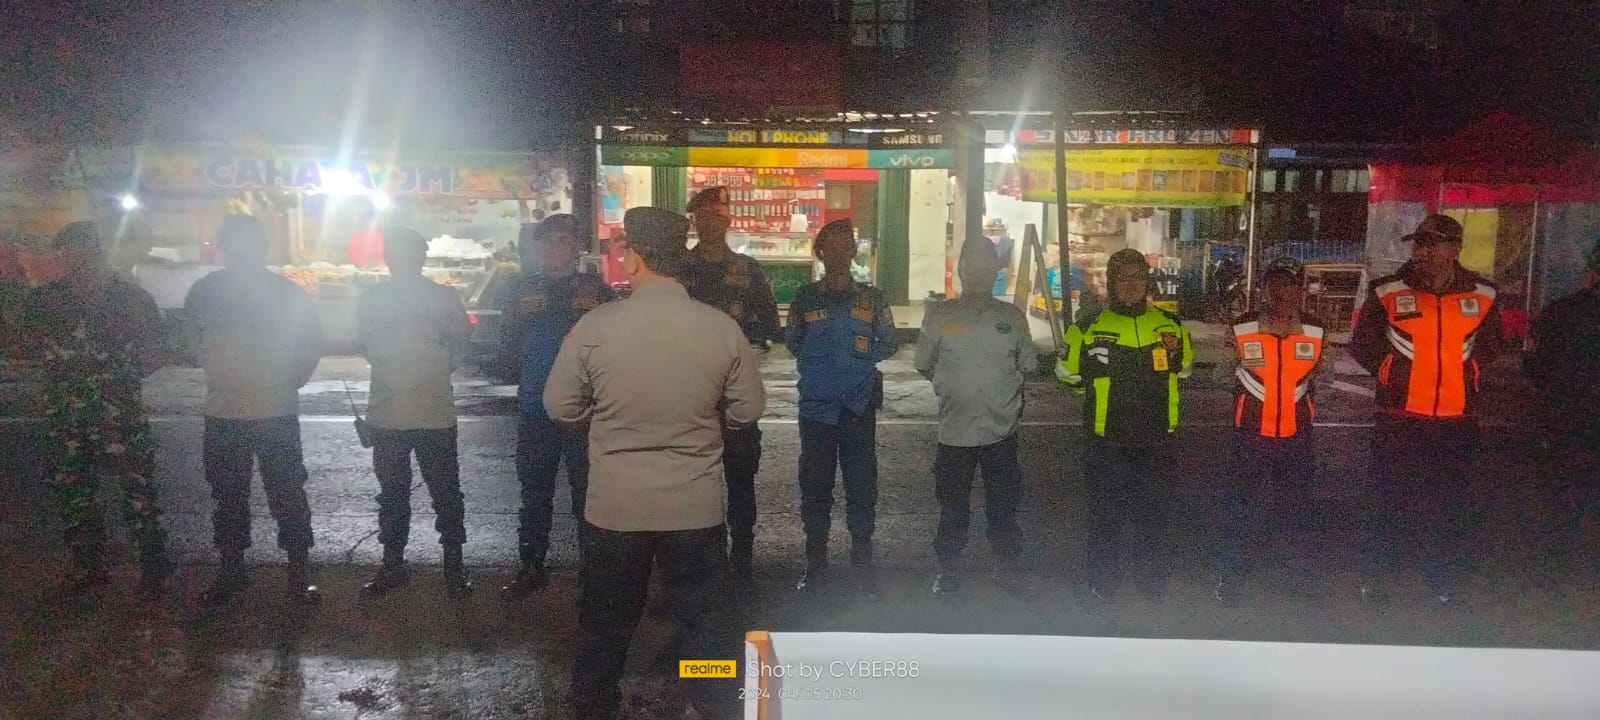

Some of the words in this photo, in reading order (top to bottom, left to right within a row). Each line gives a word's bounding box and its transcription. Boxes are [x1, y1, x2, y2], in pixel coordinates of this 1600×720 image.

[1034, 128, 1119, 144] SNAR
[799, 151, 848, 166] Redmi
[888, 154, 935, 166] vivo
[205, 158, 377, 192] CAHAA
